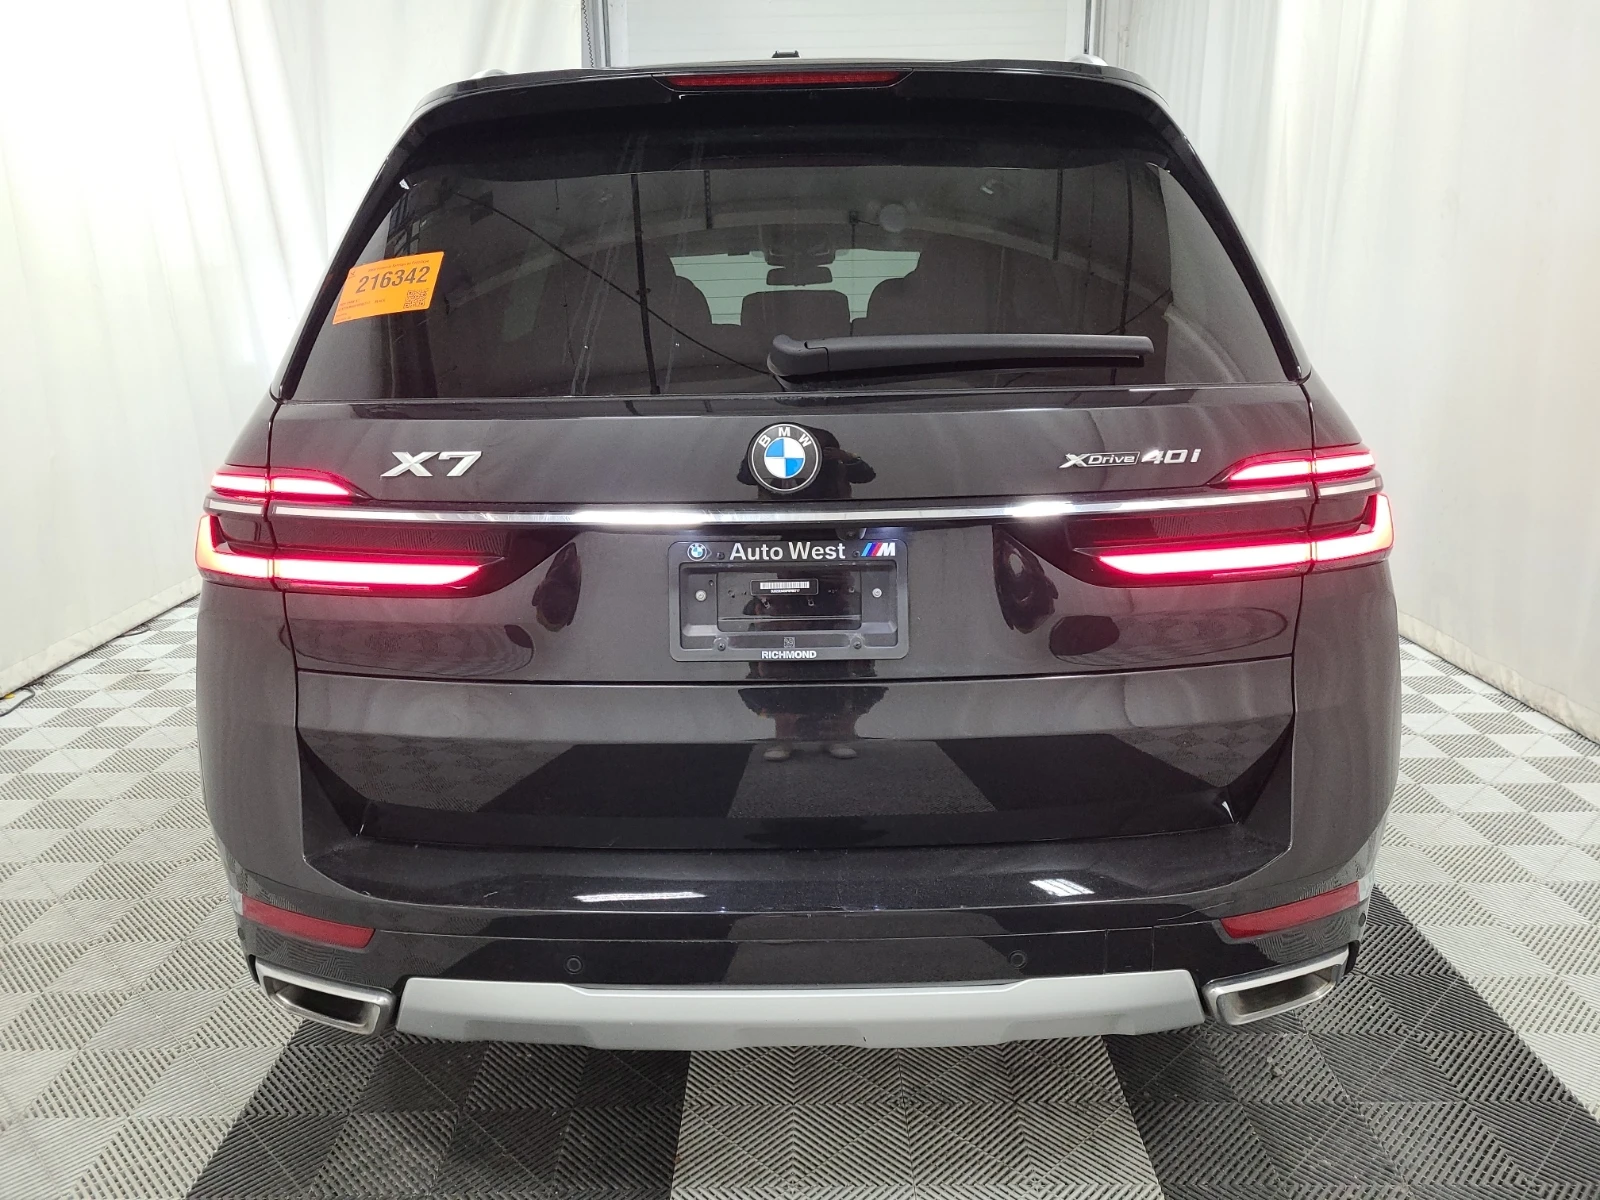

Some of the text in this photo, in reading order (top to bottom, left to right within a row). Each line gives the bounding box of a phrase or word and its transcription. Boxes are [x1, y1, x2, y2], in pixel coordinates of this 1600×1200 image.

[356, 266, 430, 294] 216342
[758, 426, 812, 448] BMW
[380, 450, 482, 477] X7
[729, 541, 846, 560] Auto West
[761, 650, 817, 659] RICHMOND
